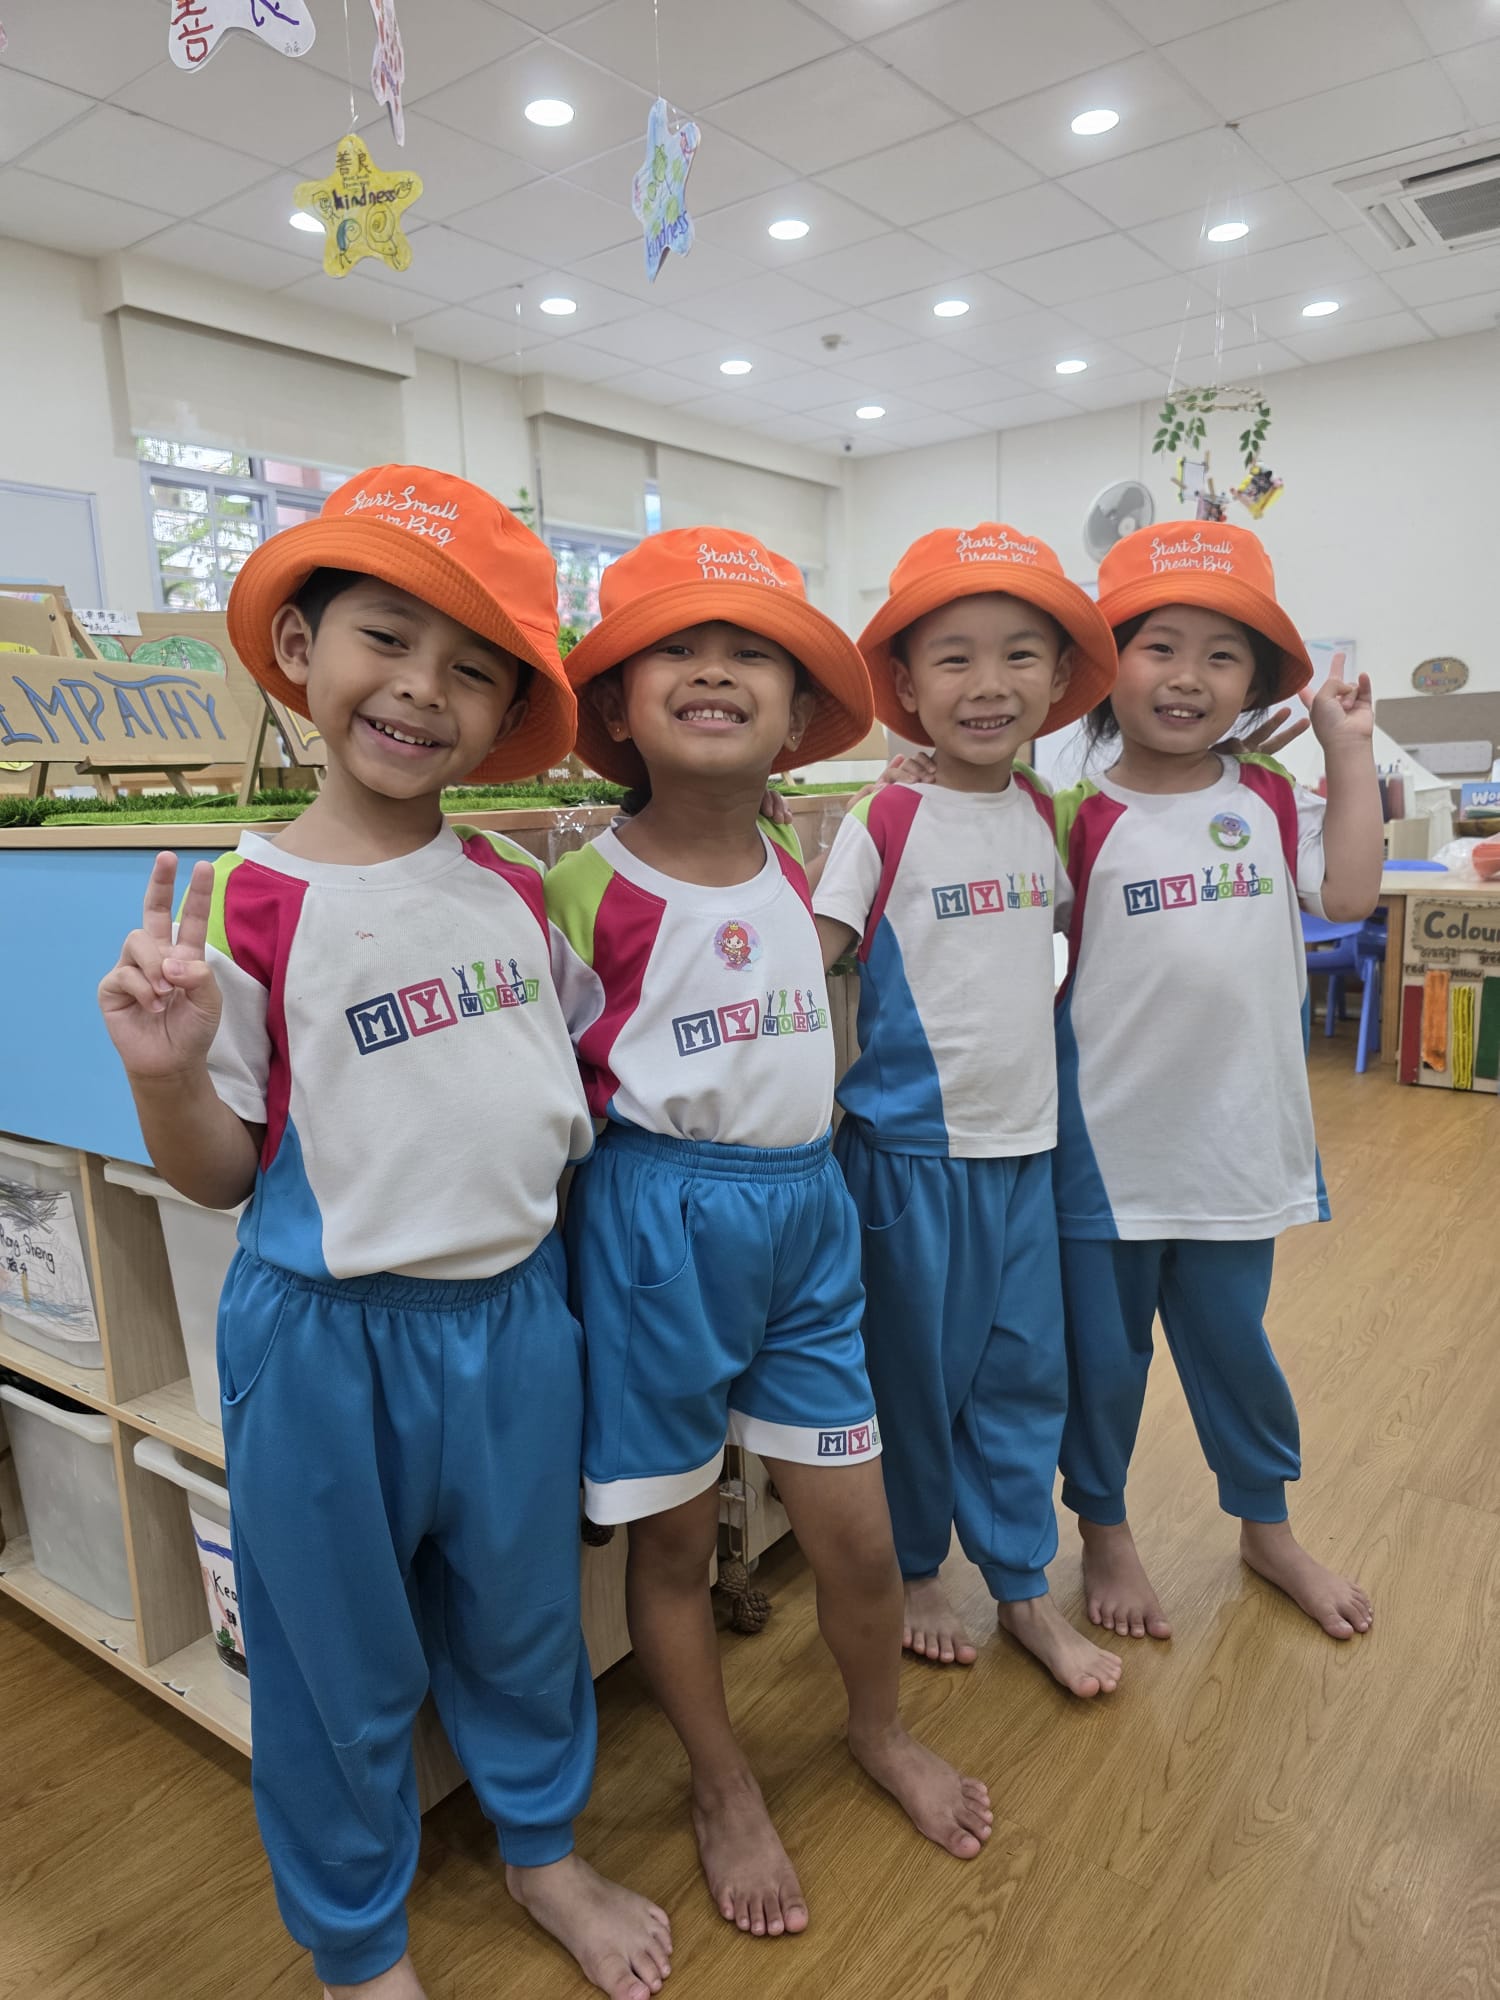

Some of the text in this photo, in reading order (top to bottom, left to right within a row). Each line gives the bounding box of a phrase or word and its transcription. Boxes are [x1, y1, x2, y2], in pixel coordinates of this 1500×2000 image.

[332, 183, 396, 210] kindness
[647, 210, 688, 259] kindness
[345, 486, 459, 520] Start Small
[406, 515, 456, 547] Big
[956, 531, 1038, 555] Start Small
[1150, 533, 1233, 560] Start Small
[697, 544, 787, 587] Start Sma
[1153, 555, 1233, 575] Dream Big
[936, 883, 1000, 916] MY
[1127, 877, 1271, 913] MY WORLD
[352, 981, 537, 1050] MY WORLD
[677, 1003, 827, 1052] MY WORLD
[820, 1428, 868, 1454] MY
